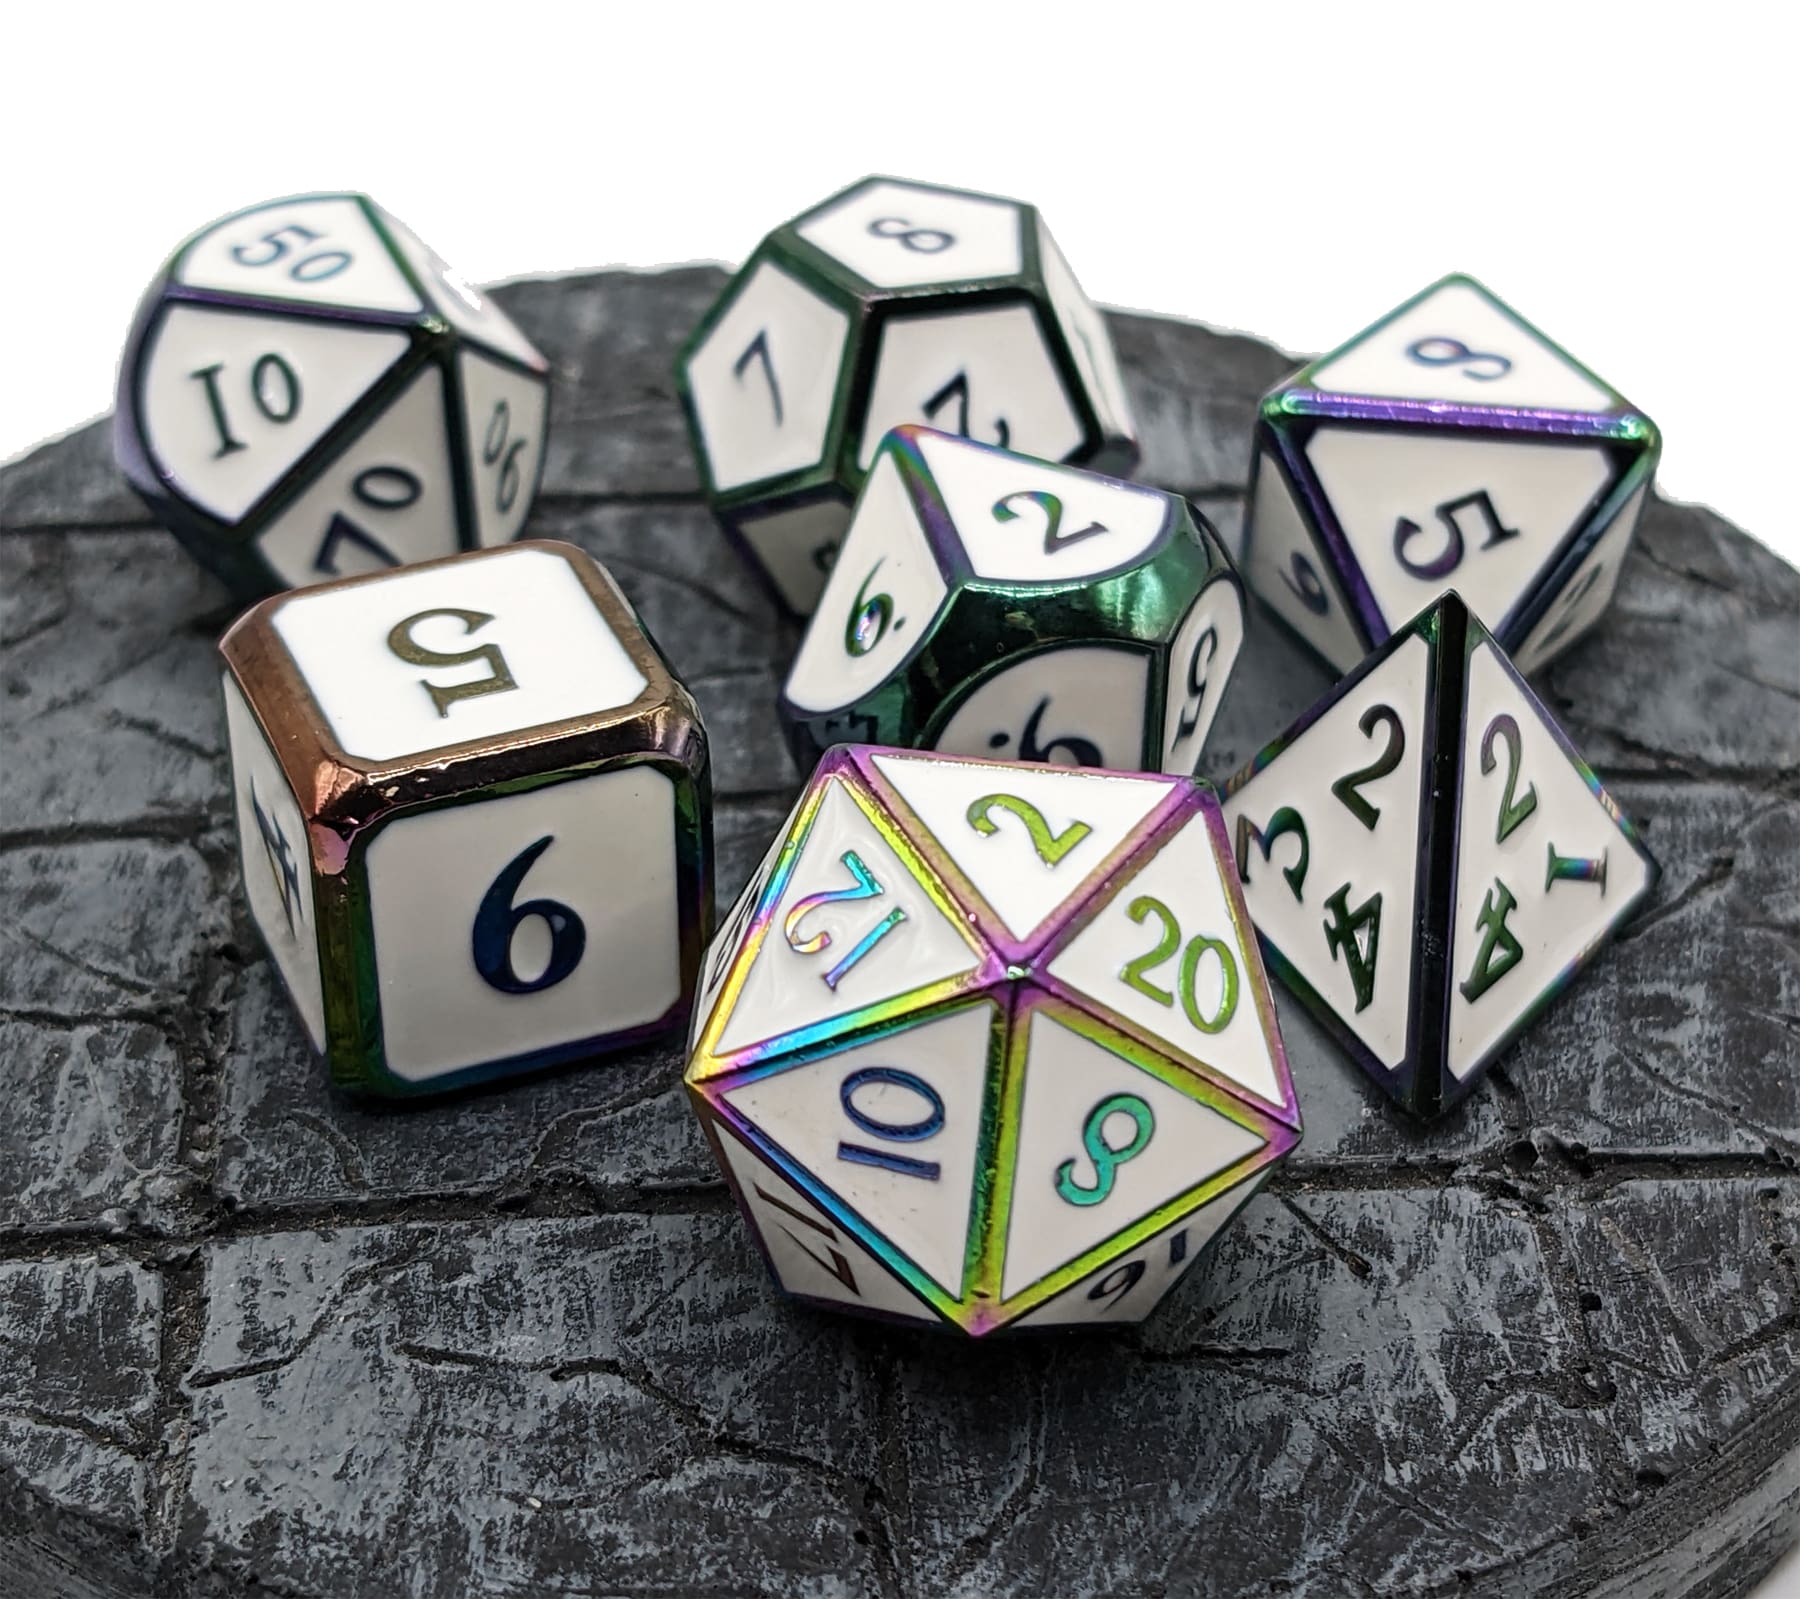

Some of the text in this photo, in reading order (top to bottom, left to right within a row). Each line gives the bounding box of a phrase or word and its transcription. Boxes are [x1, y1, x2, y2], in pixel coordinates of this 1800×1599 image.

[231, 225, 353, 283] 50
[868, 216, 956, 254] 8
[189, 352, 302, 460] 10
[1406, 336, 1513, 382] 8
[991, 489, 1110, 556] 2
[1392, 488, 1521, 581] 5
[387, 607, 521, 718] 5
[1171, 626, 1218, 754] 5
[1331, 703, 1407, 832] 2
[1480, 713, 1539, 846] 2
[249, 774, 303, 943] 4
[966, 792, 1095, 868] 2
[1236, 805, 1311, 904] 3
[1544, 841, 1609, 898] 1
[471, 833, 587, 995] 6
[783, 850, 908, 992] 12
[1118, 895, 1240, 1034] 20
[1322, 881, 1384, 1015] 4
[1458, 876, 1524, 1005] 4
[836, 1066, 946, 1182] 10
[1053, 1091, 1156, 1208] 8
